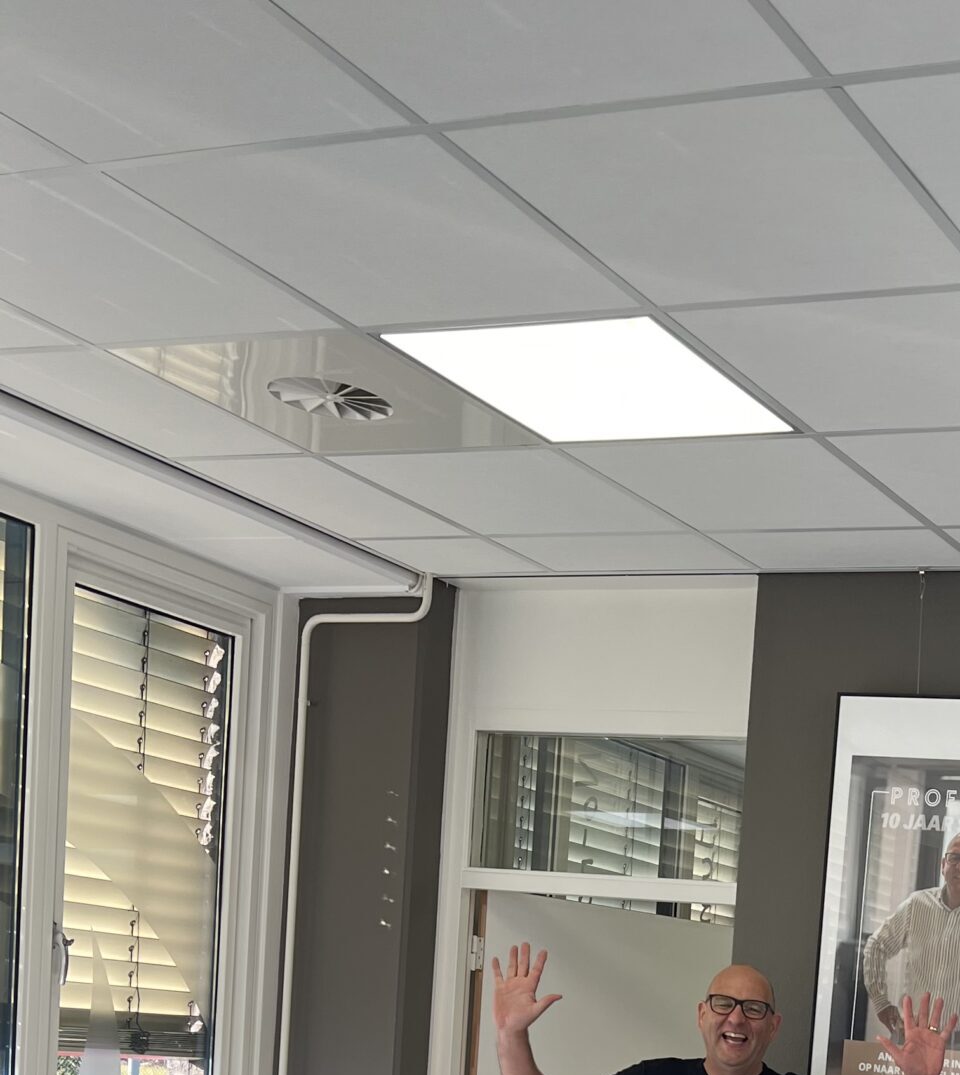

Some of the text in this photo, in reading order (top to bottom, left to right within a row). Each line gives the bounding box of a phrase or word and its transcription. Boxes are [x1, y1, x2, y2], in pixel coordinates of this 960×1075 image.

[881, 813, 900, 829] 10
[903, 814, 953, 832] JAAR
[858, 1062, 872, 1072] OP
[873, 1064, 900, 1075] NAAR
